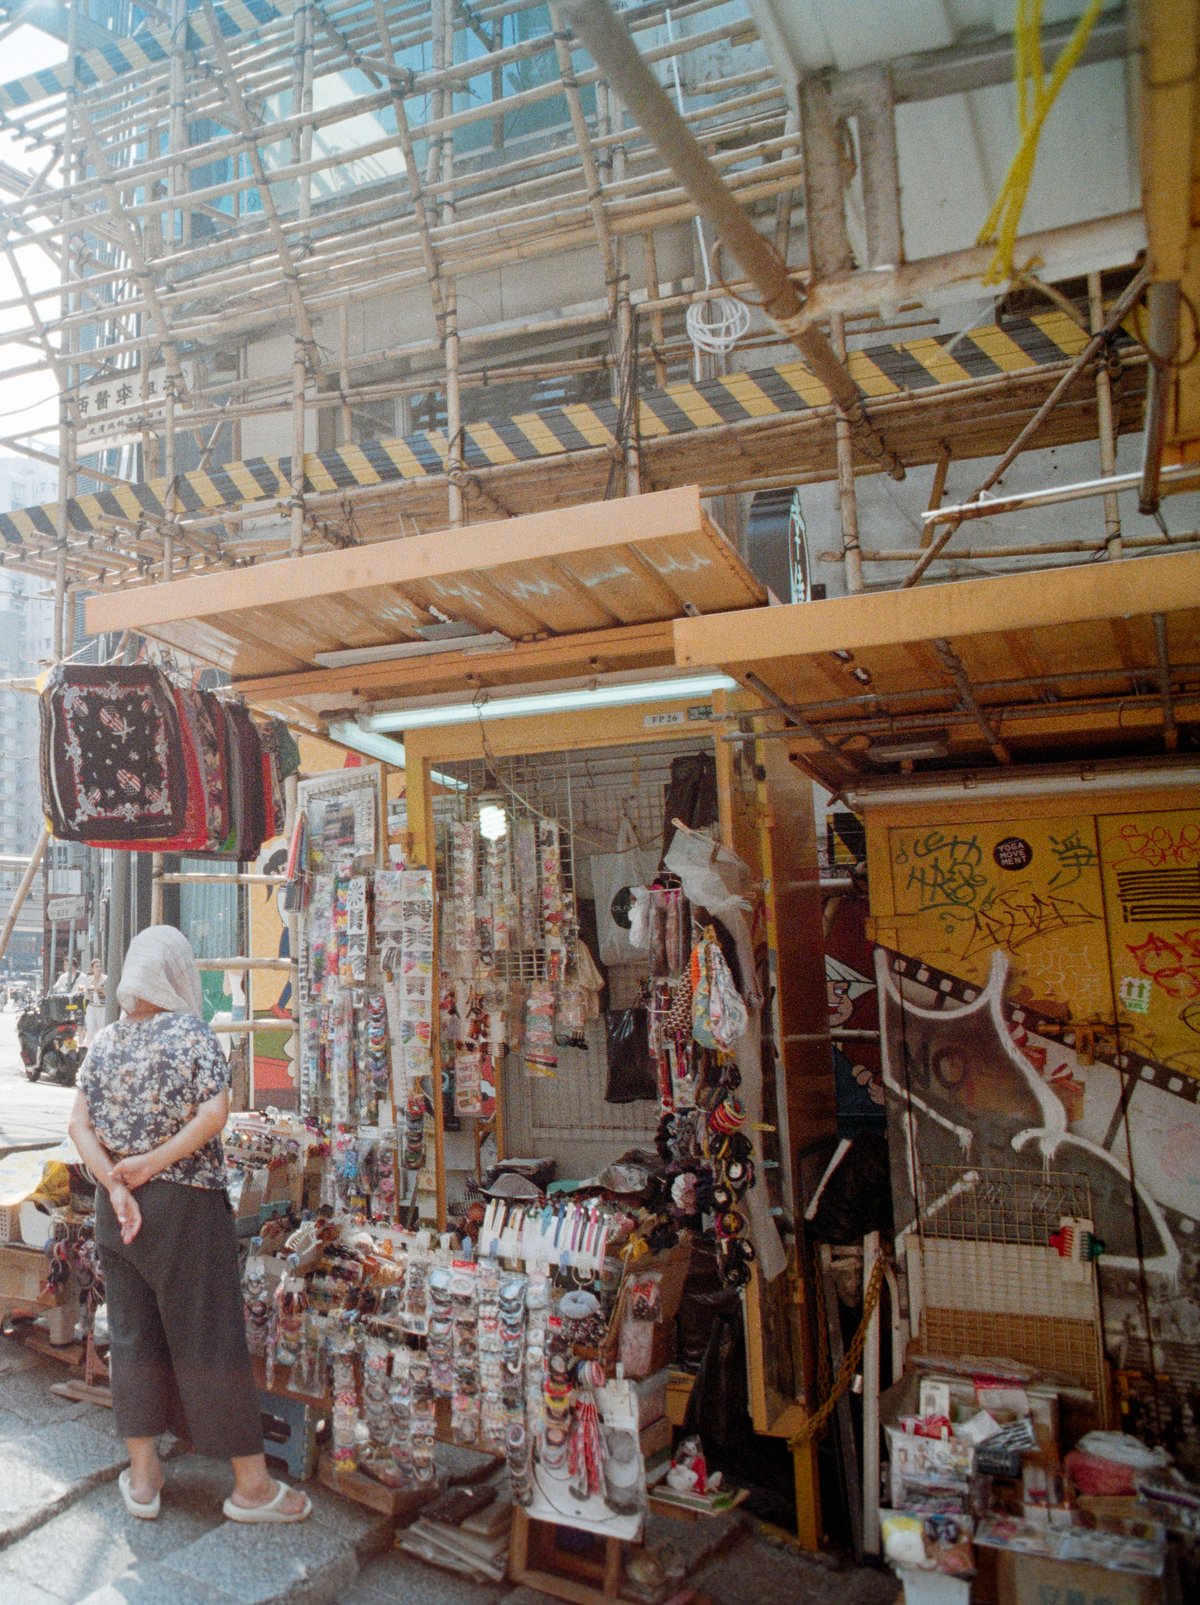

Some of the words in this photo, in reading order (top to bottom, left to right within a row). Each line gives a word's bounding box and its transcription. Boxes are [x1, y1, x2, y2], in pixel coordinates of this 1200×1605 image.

[998, 842, 1025, 851] YOGA
[1000, 849, 1026, 858] MOVE
[1001, 856, 1027, 866] MENT
